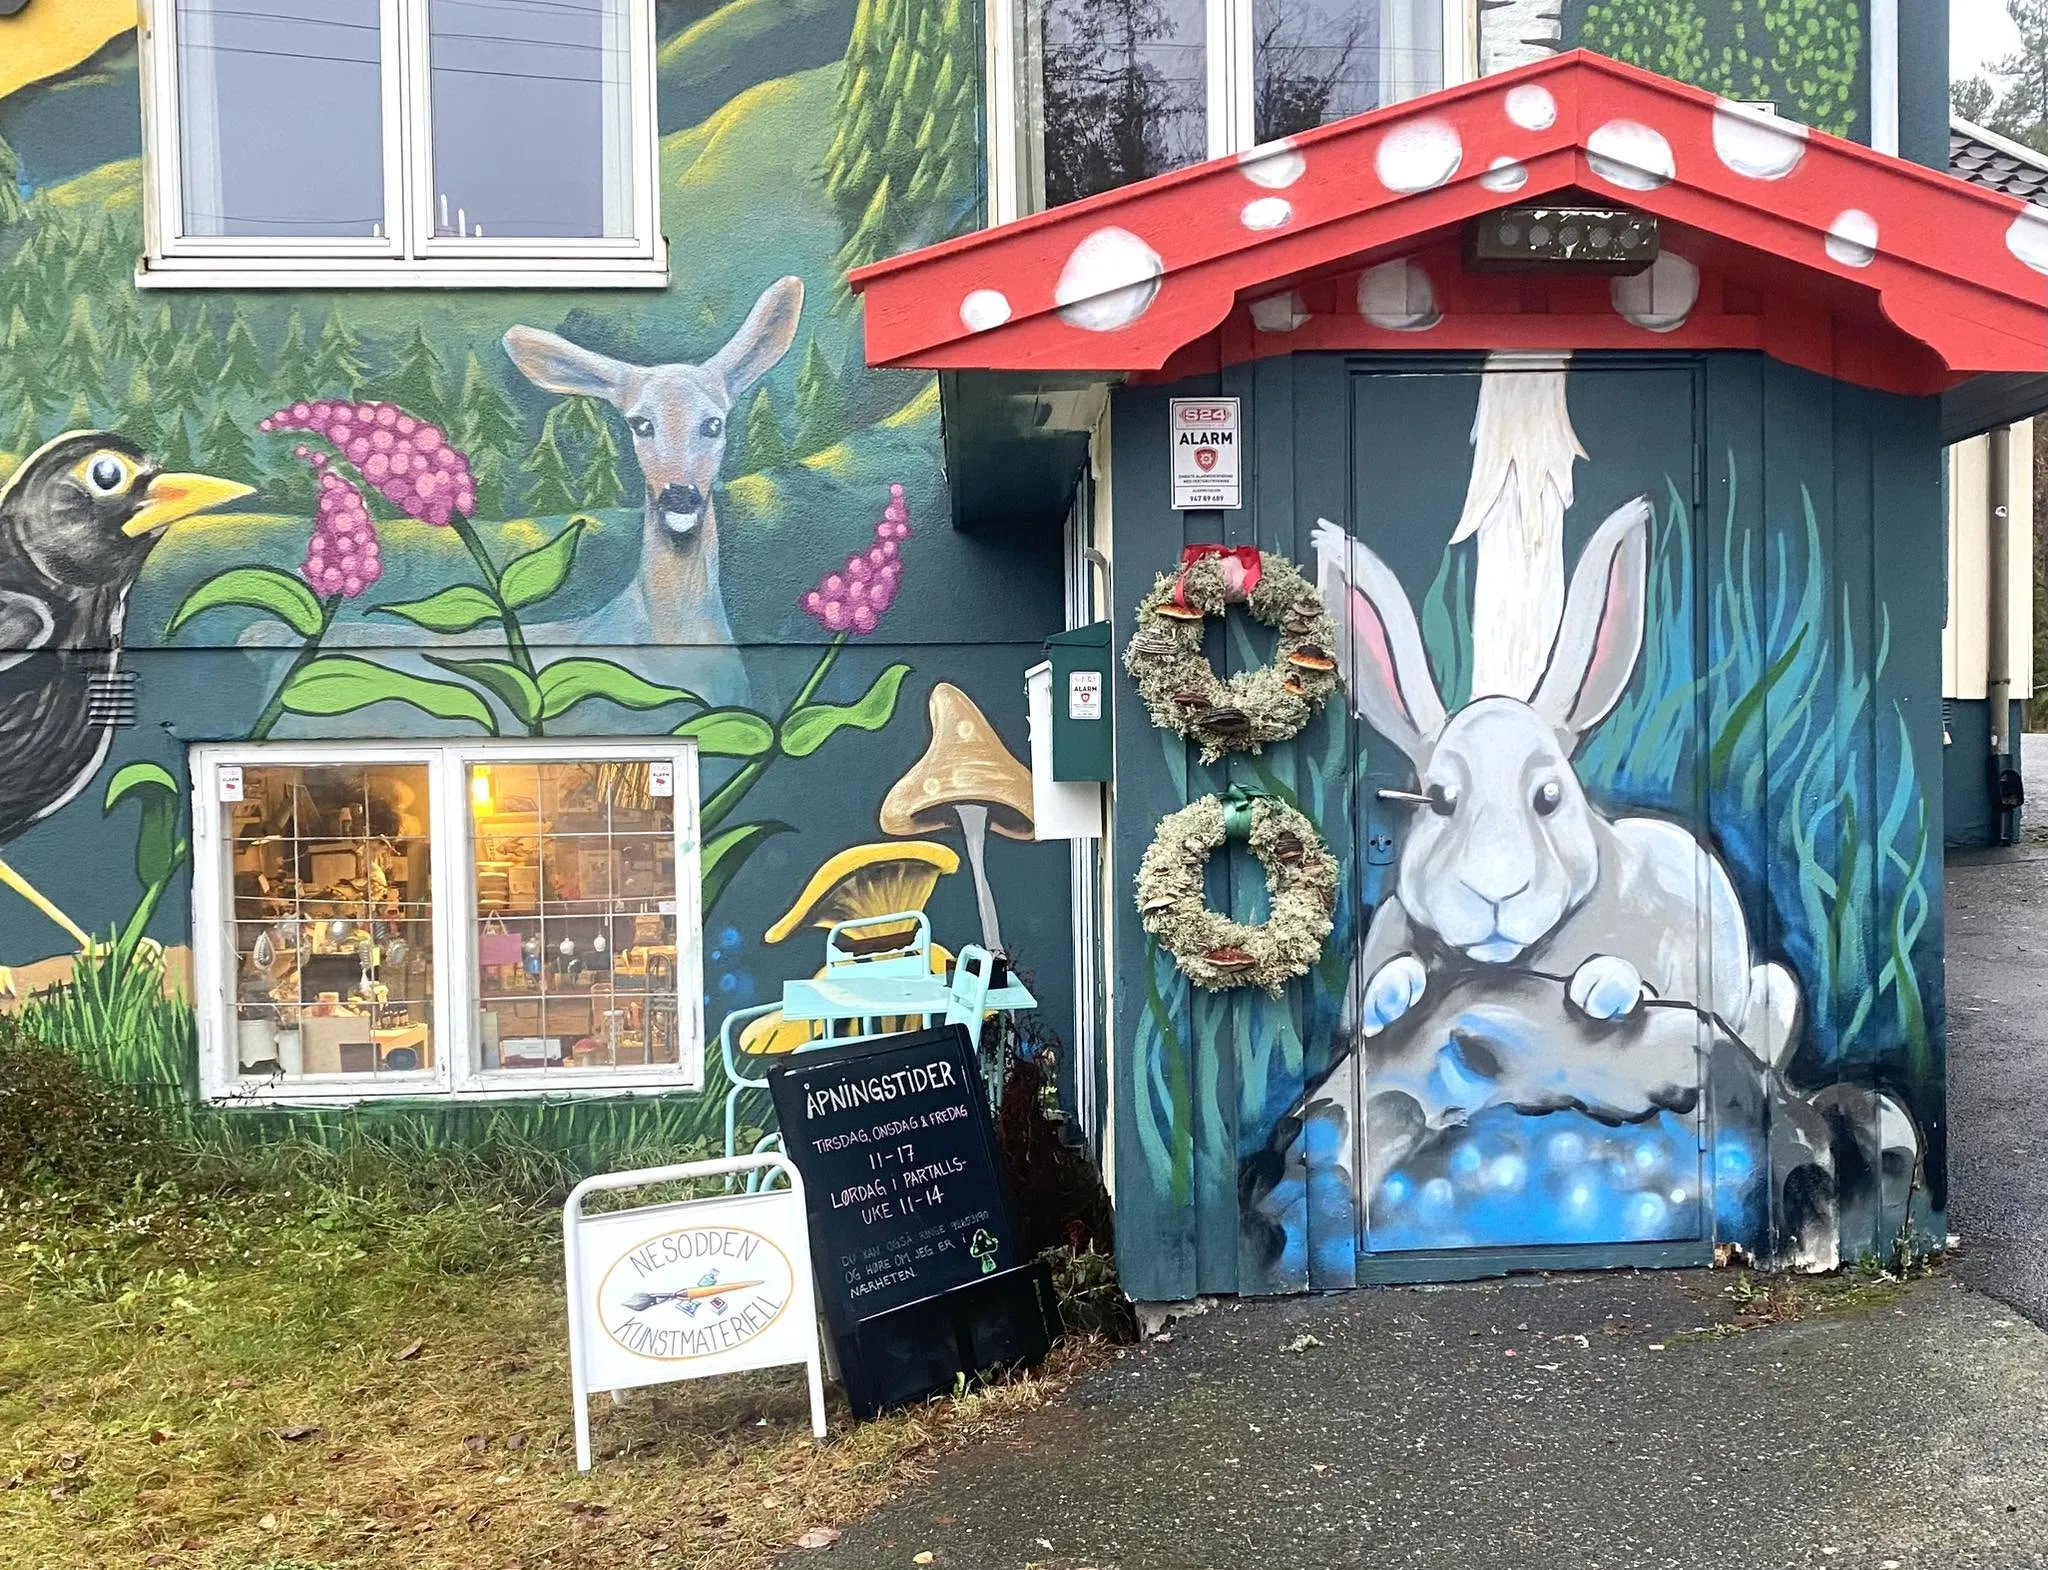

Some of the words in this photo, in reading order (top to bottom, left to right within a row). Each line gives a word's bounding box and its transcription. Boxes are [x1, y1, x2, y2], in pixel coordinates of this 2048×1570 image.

[1185, 408, 1226, 421] S24
[1179, 431, 1233, 445] ALARM
[804, 1061, 956, 1119] ÅPNINGSTIDER
[812, 1129, 872, 1154] TIRSDAG,
[872, 1116, 919, 1141] ONSDAG
[920, 1115, 929, 1128] &
[929, 1104, 968, 1126] FREDAG
[869, 1144, 914, 1170] 11-17
[831, 1179, 886, 1209] LØRDAG
[903, 1157, 967, 1189] PARTALLS-
[861, 1202, 893, 1225] UKE
[899, 1184, 945, 1215] 11-14
[628, 1231, 760, 1278] NESODDEN
[841, 1253, 857, 1267] DU
[844, 1268, 861, 1284] OG
[866, 1258, 891, 1276] HØRE
[894, 1253, 911, 1268] OM
[914, 1246, 934, 1260] JEG
[938, 1238, 956, 1252] ER
[849, 1267, 918, 1299] NÆRHETEN.
[612, 1295, 783, 1356] KUNSTMATERIELL
